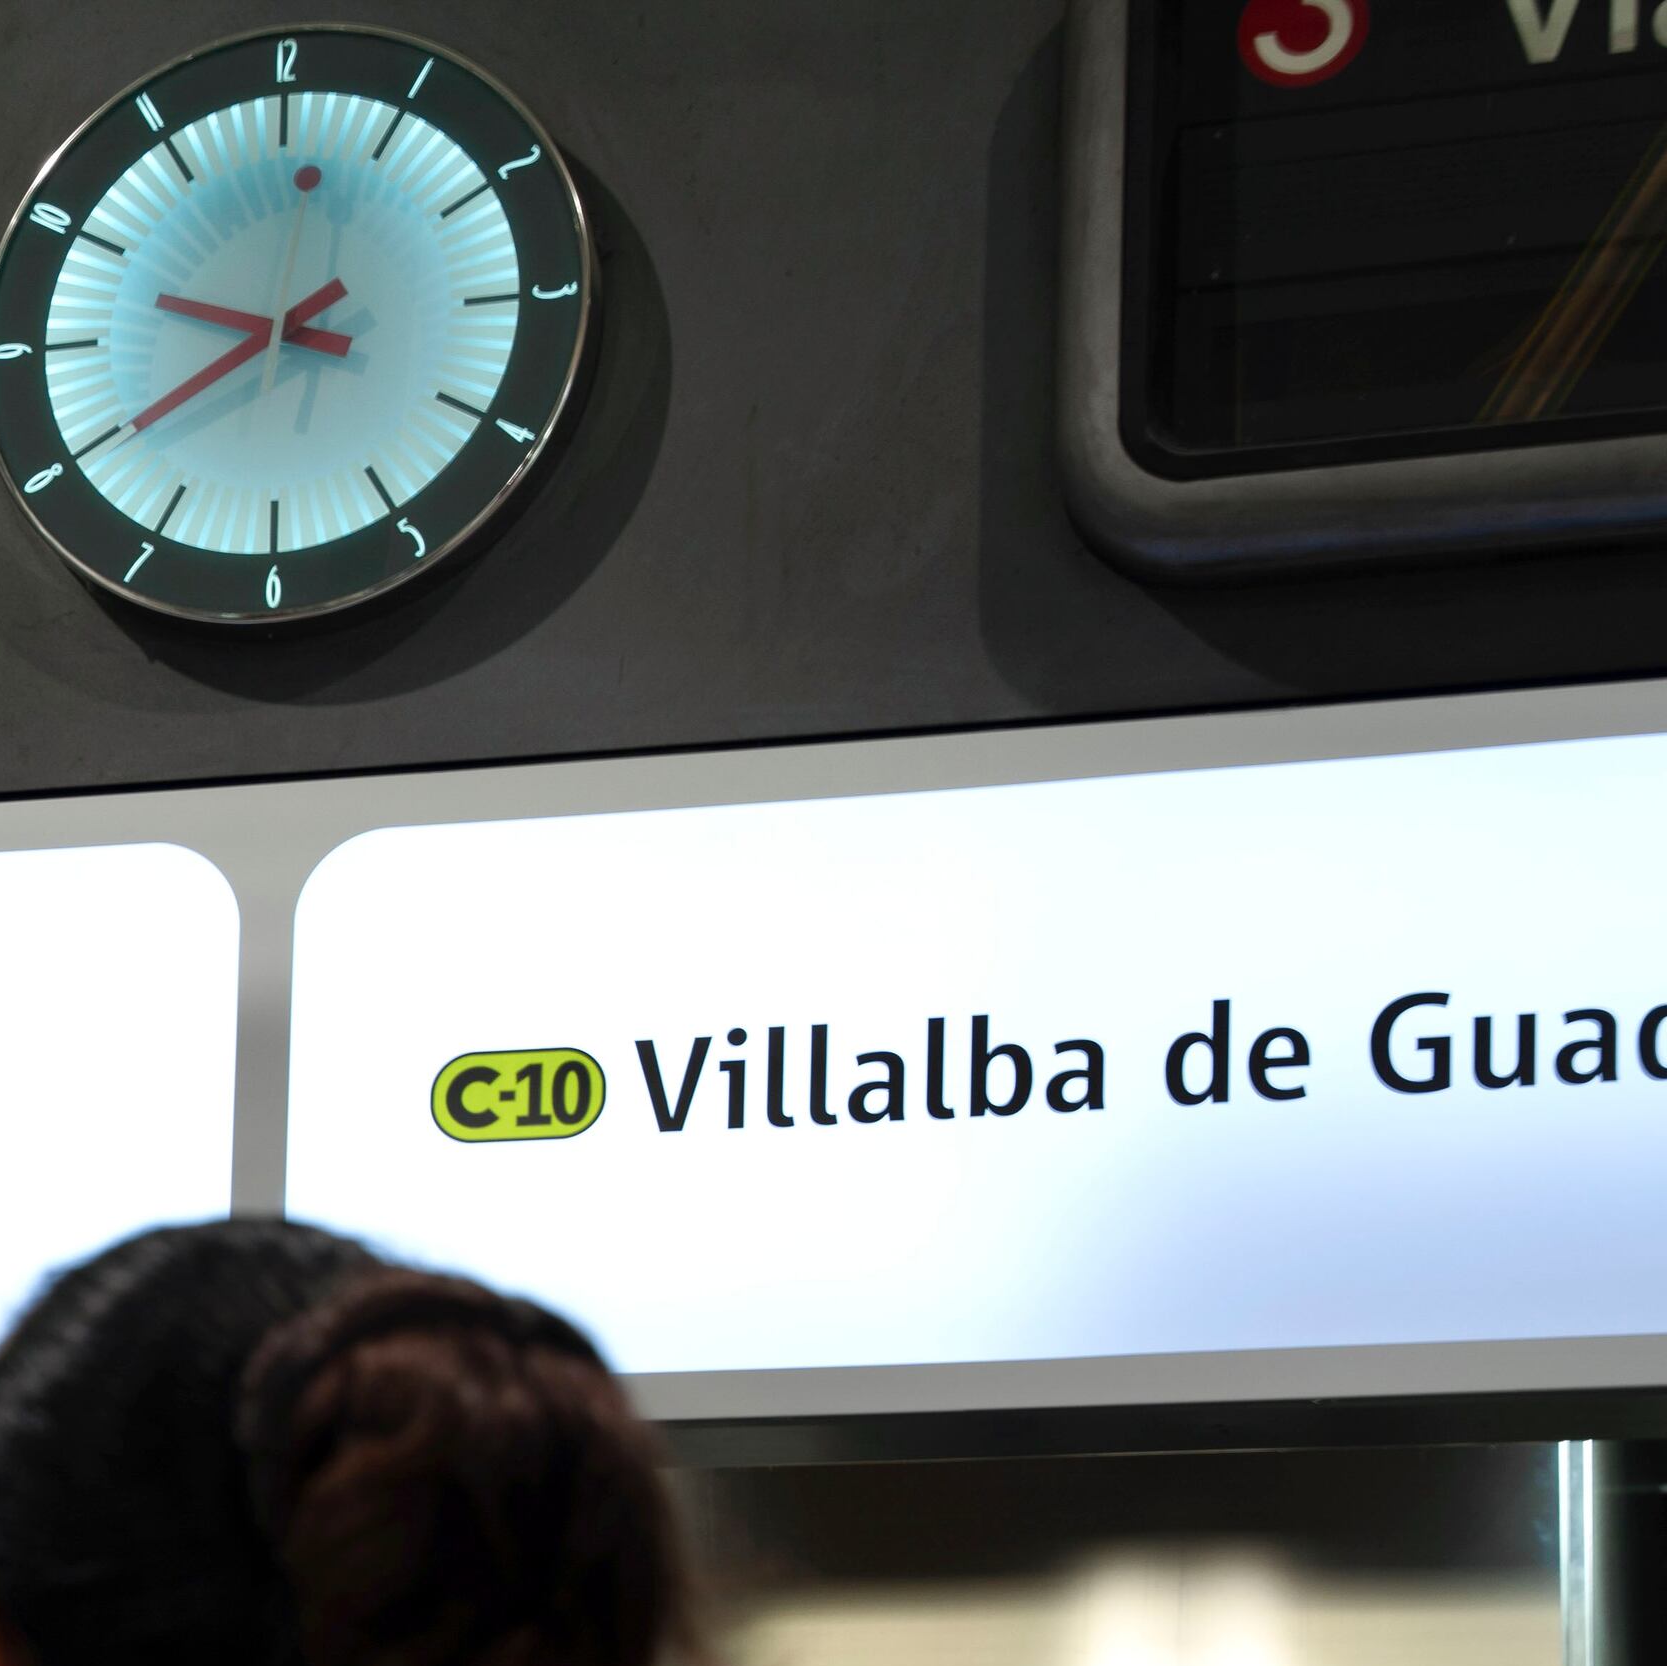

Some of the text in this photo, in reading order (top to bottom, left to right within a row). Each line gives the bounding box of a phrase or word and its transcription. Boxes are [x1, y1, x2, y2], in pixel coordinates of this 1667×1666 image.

[276, 38, 299, 83] 12
[408, 57, 434, 98] 1
[135, 91, 165, 131] 11
[499, 145, 540, 179] 2
[29, 202, 71, 234] 10
[531, 281, 578, 300] 3
[495, 417, 537, 443] 4
[24, 462, 63, 494] 8
[396, 516, 425, 558] 5
[124, 541, 155, 582] 7
[265, 566, 282, 608] 6
[444, 1059, 593, 1130] C-10
[632, 1014, 1107, 1134] Villalba
[1163, 999, 1312, 1105] de
